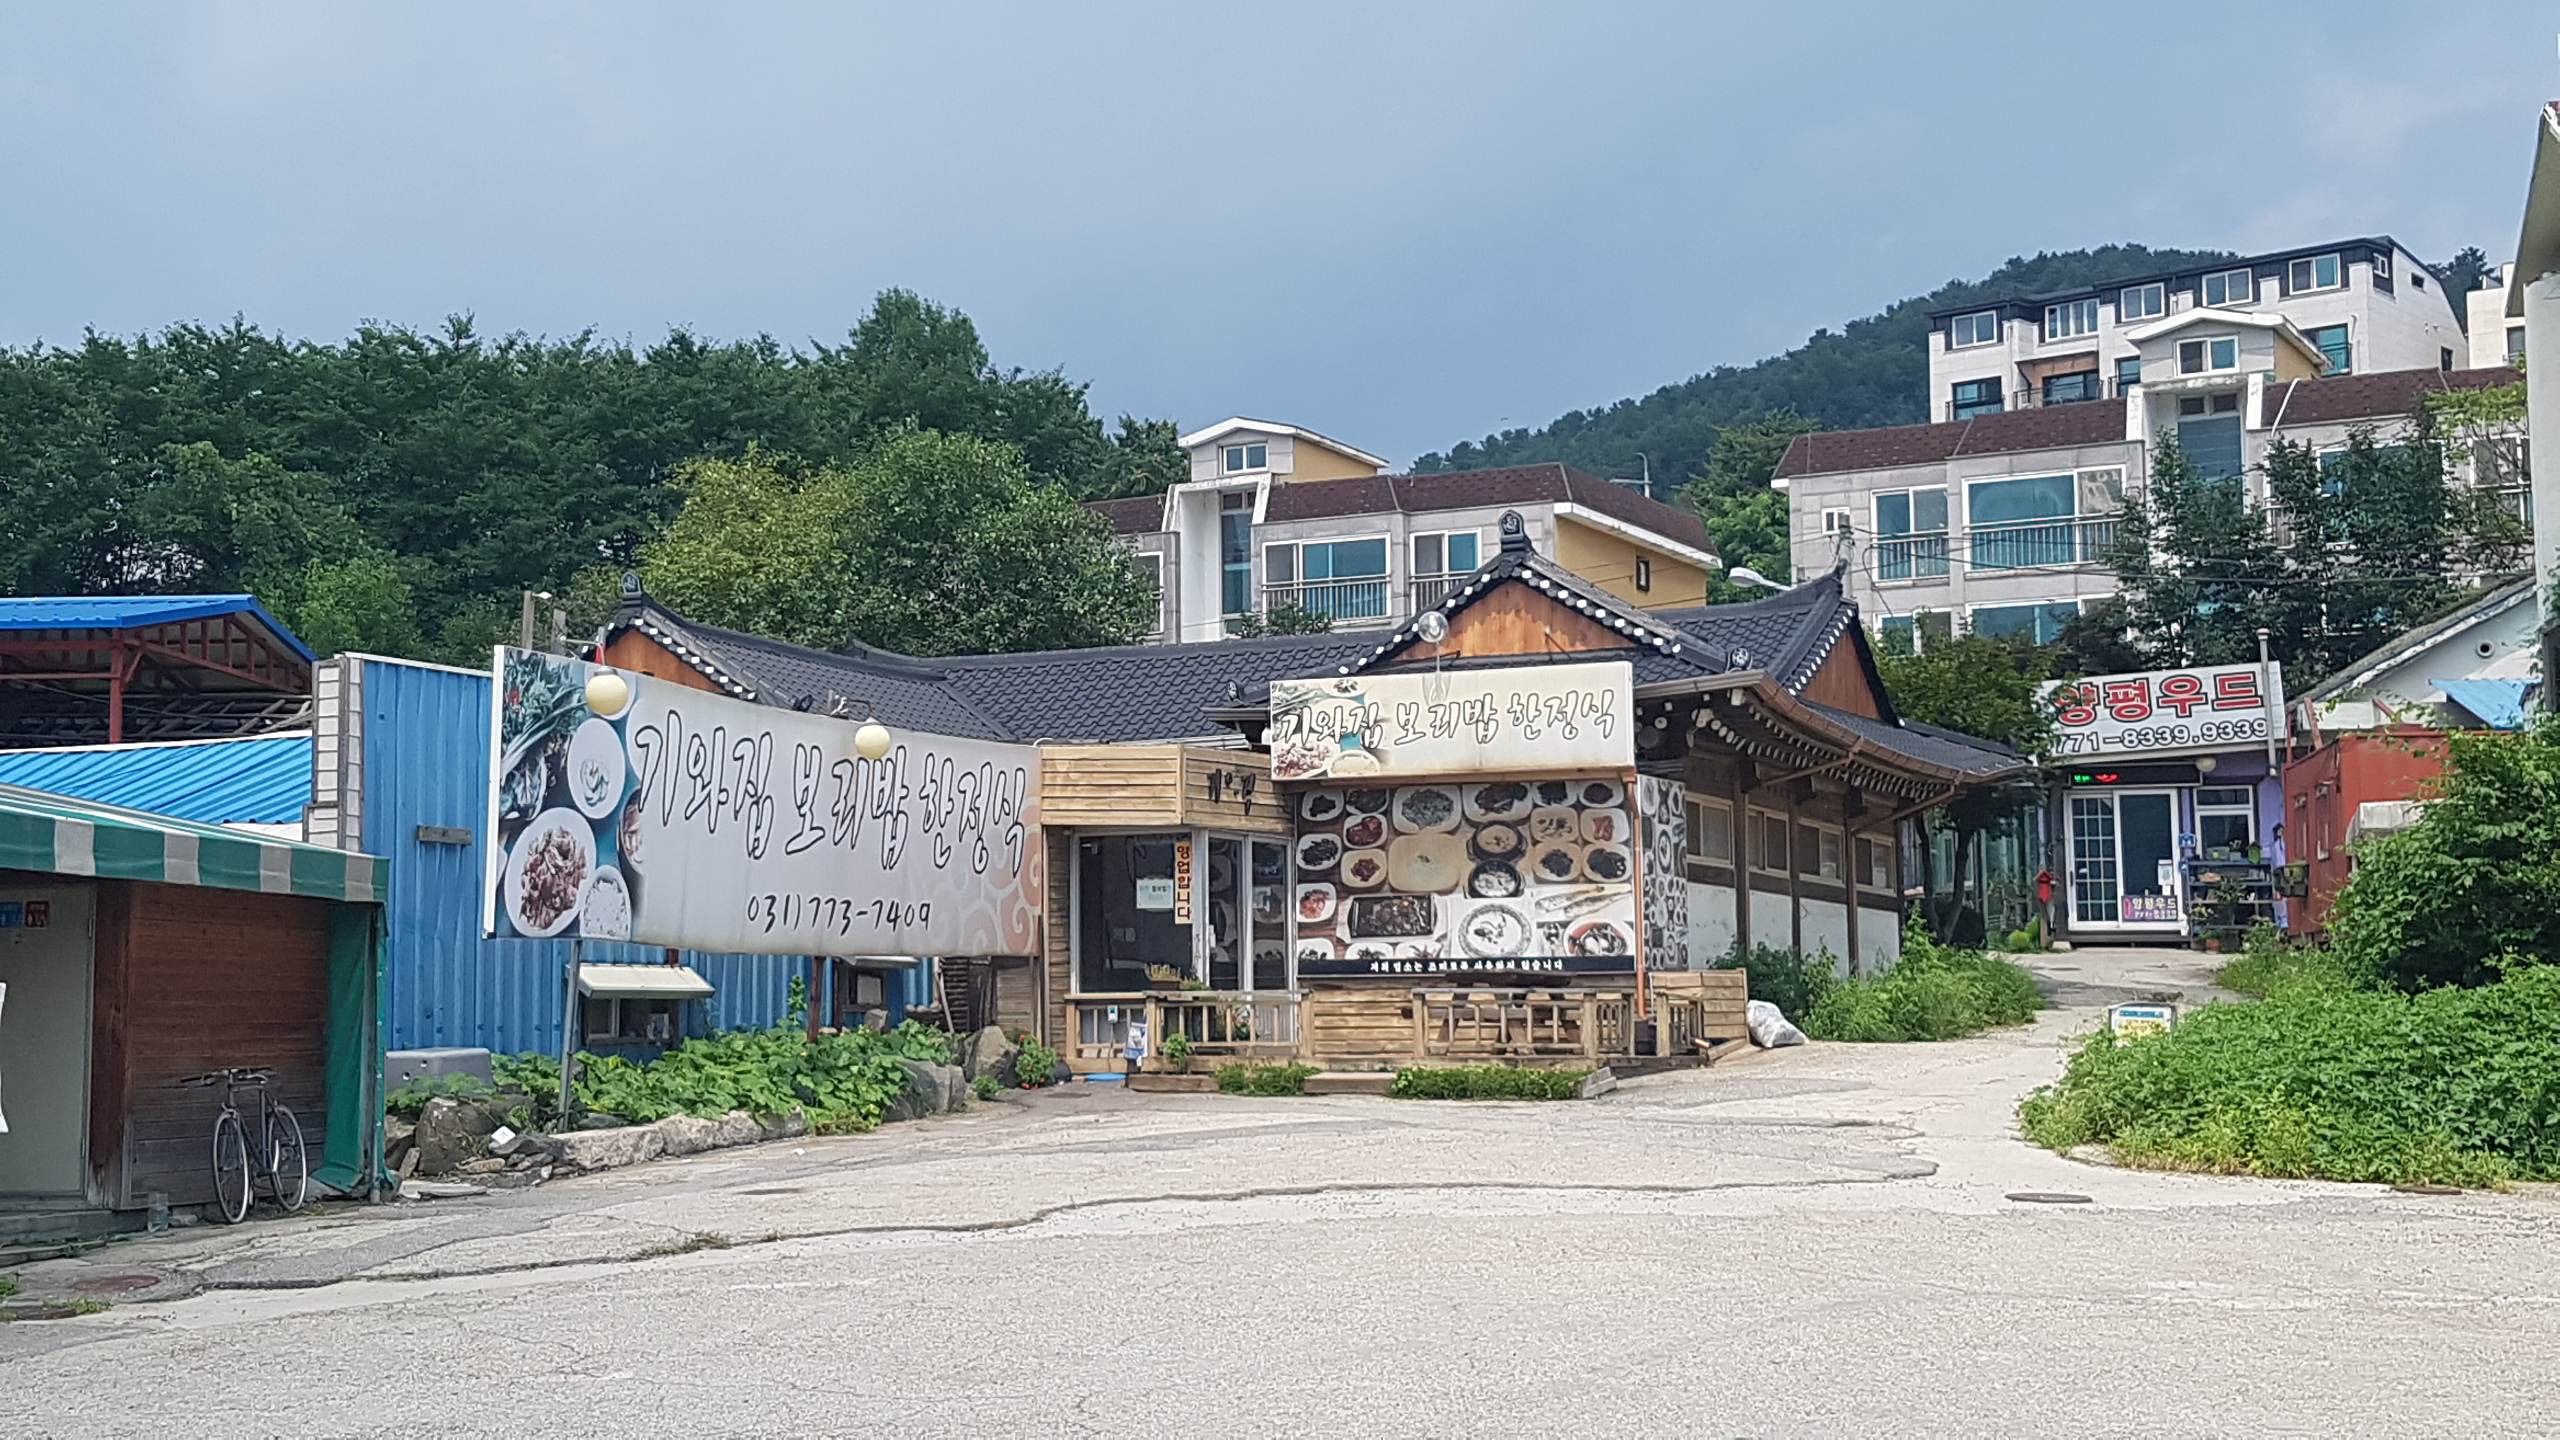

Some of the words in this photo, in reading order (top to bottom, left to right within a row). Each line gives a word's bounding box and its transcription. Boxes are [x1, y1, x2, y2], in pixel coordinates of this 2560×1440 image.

[1280, 702, 1383, 749] 기와집
[1394, 693, 1498, 744] 보리밥
[1507, 689, 1614, 740] 한정식
[2051, 671, 2264, 727] 양평우드
[634, 709, 774, 859] 기와집
[785, 743, 908, 869] 보리밥
[919, 752, 1026, 877] 한정식
